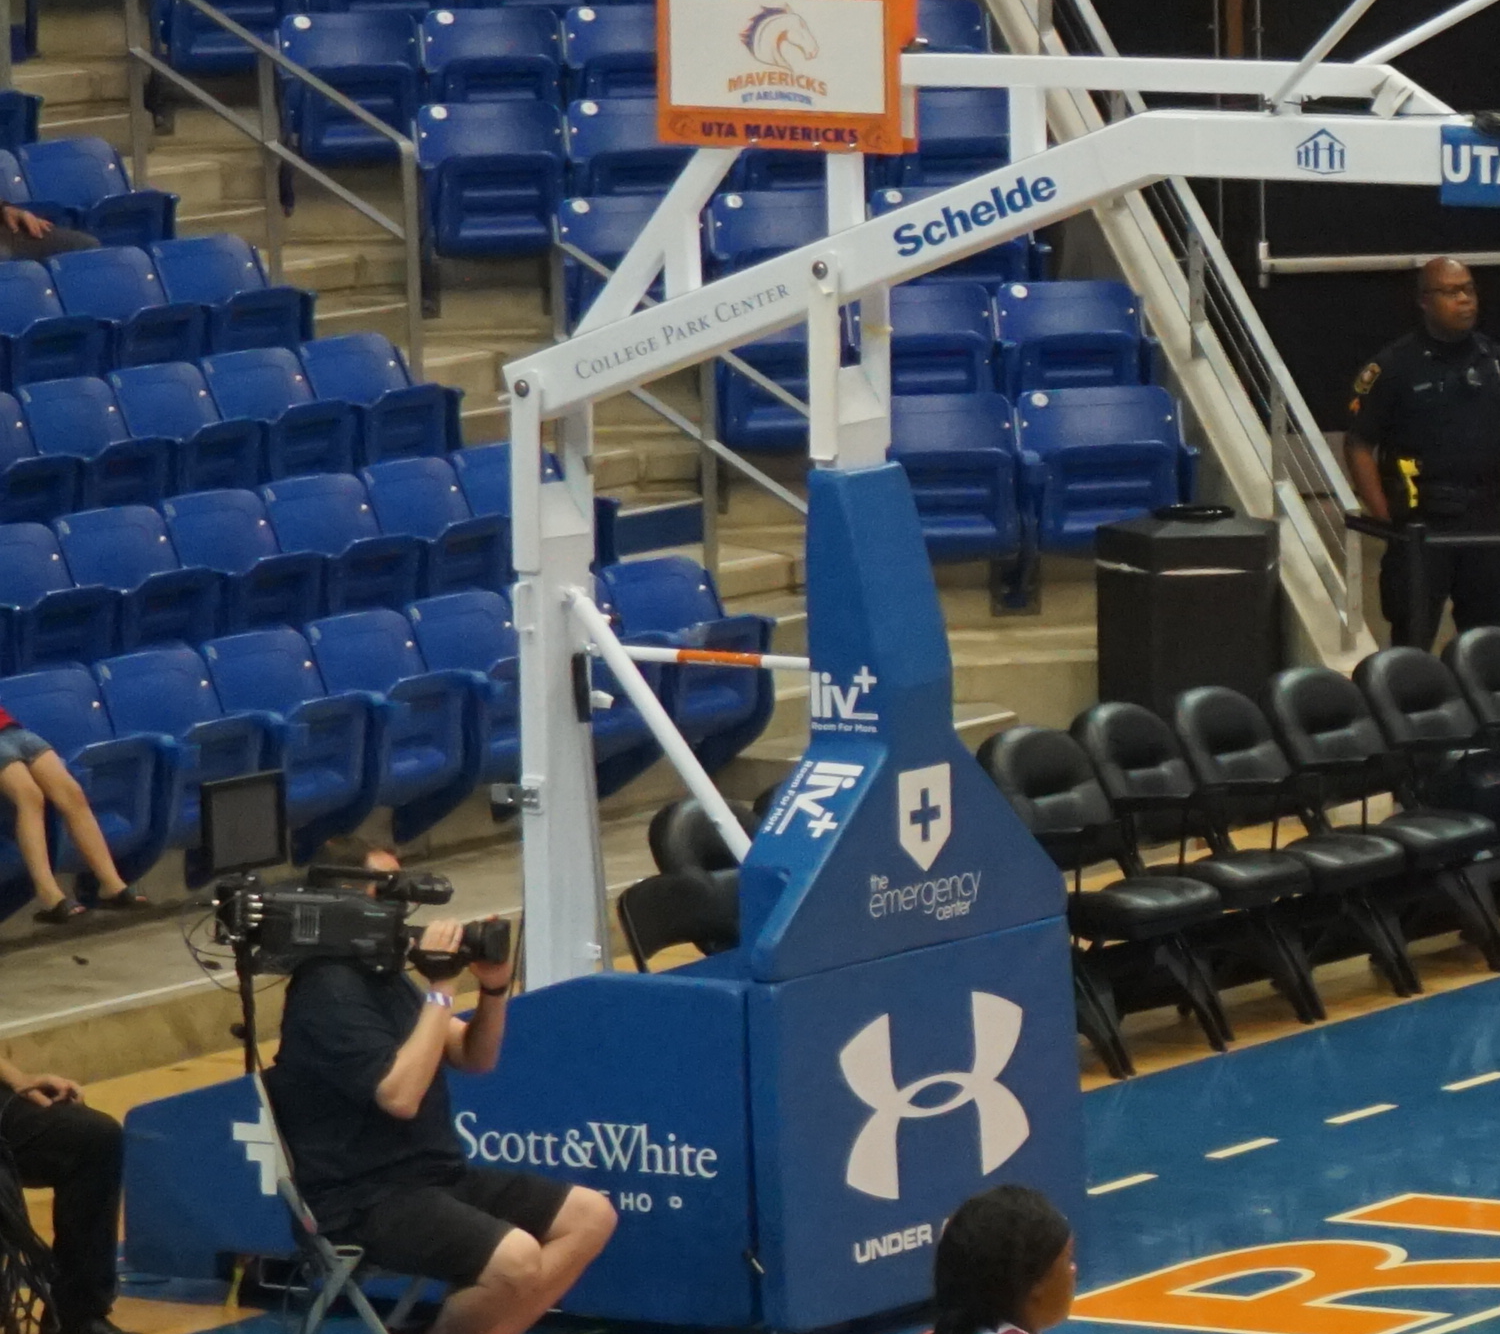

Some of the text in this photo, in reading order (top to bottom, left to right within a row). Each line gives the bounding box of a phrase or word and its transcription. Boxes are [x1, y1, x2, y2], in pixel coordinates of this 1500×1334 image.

[727, 70, 828, 96] MAVERICKS
[701, 121, 859, 144] UTA MAVERICKS
[893, 175, 1057, 257] Schelde
[575, 283, 791, 379] COLLEGE PARK CENTER
[869, 874, 889, 892] the
[869, 870, 982, 919] emergency
[936, 900, 972, 921] center
[853, 1223, 933, 1265] UNDER
